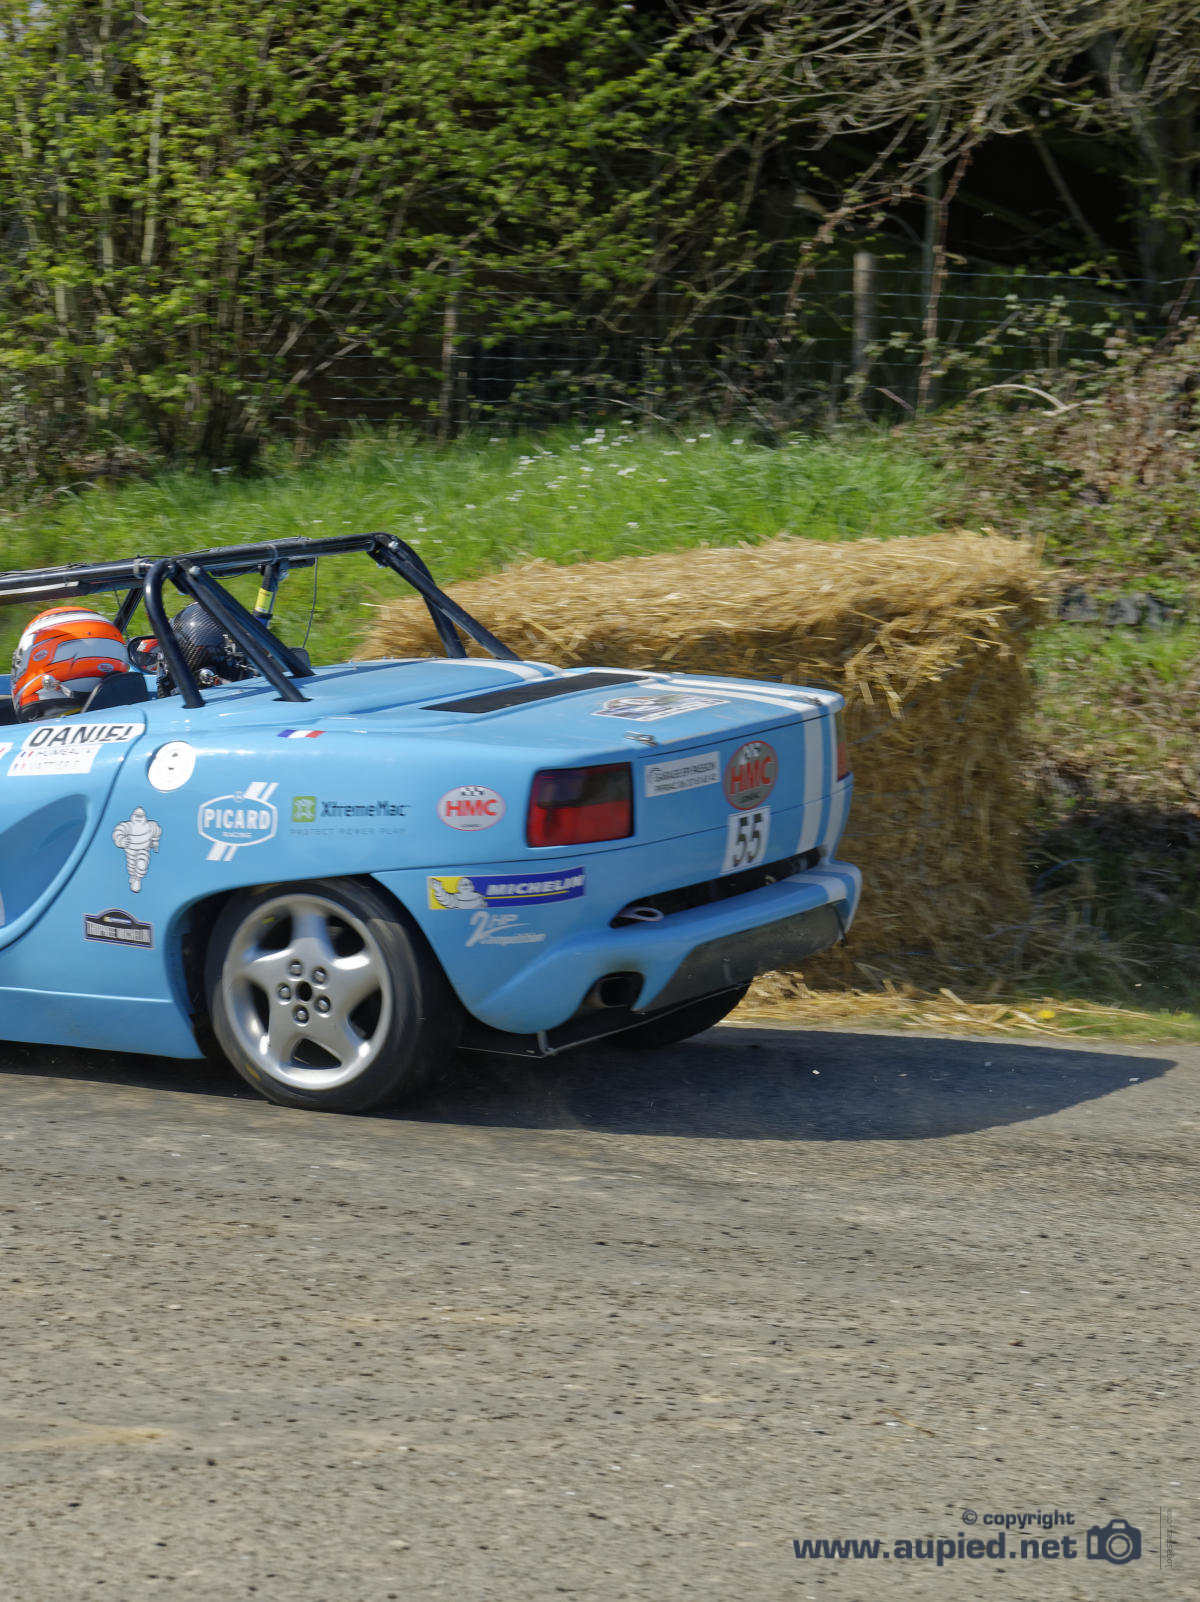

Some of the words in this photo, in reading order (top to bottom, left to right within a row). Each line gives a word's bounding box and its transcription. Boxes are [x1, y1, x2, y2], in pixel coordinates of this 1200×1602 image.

[730, 757, 772, 795] HMC
[446, 799, 497, 816] HMC
[203, 808, 271, 830] PICARD
[733, 813, 764, 867] 55
[486, 875, 585, 896] MICHELIN
